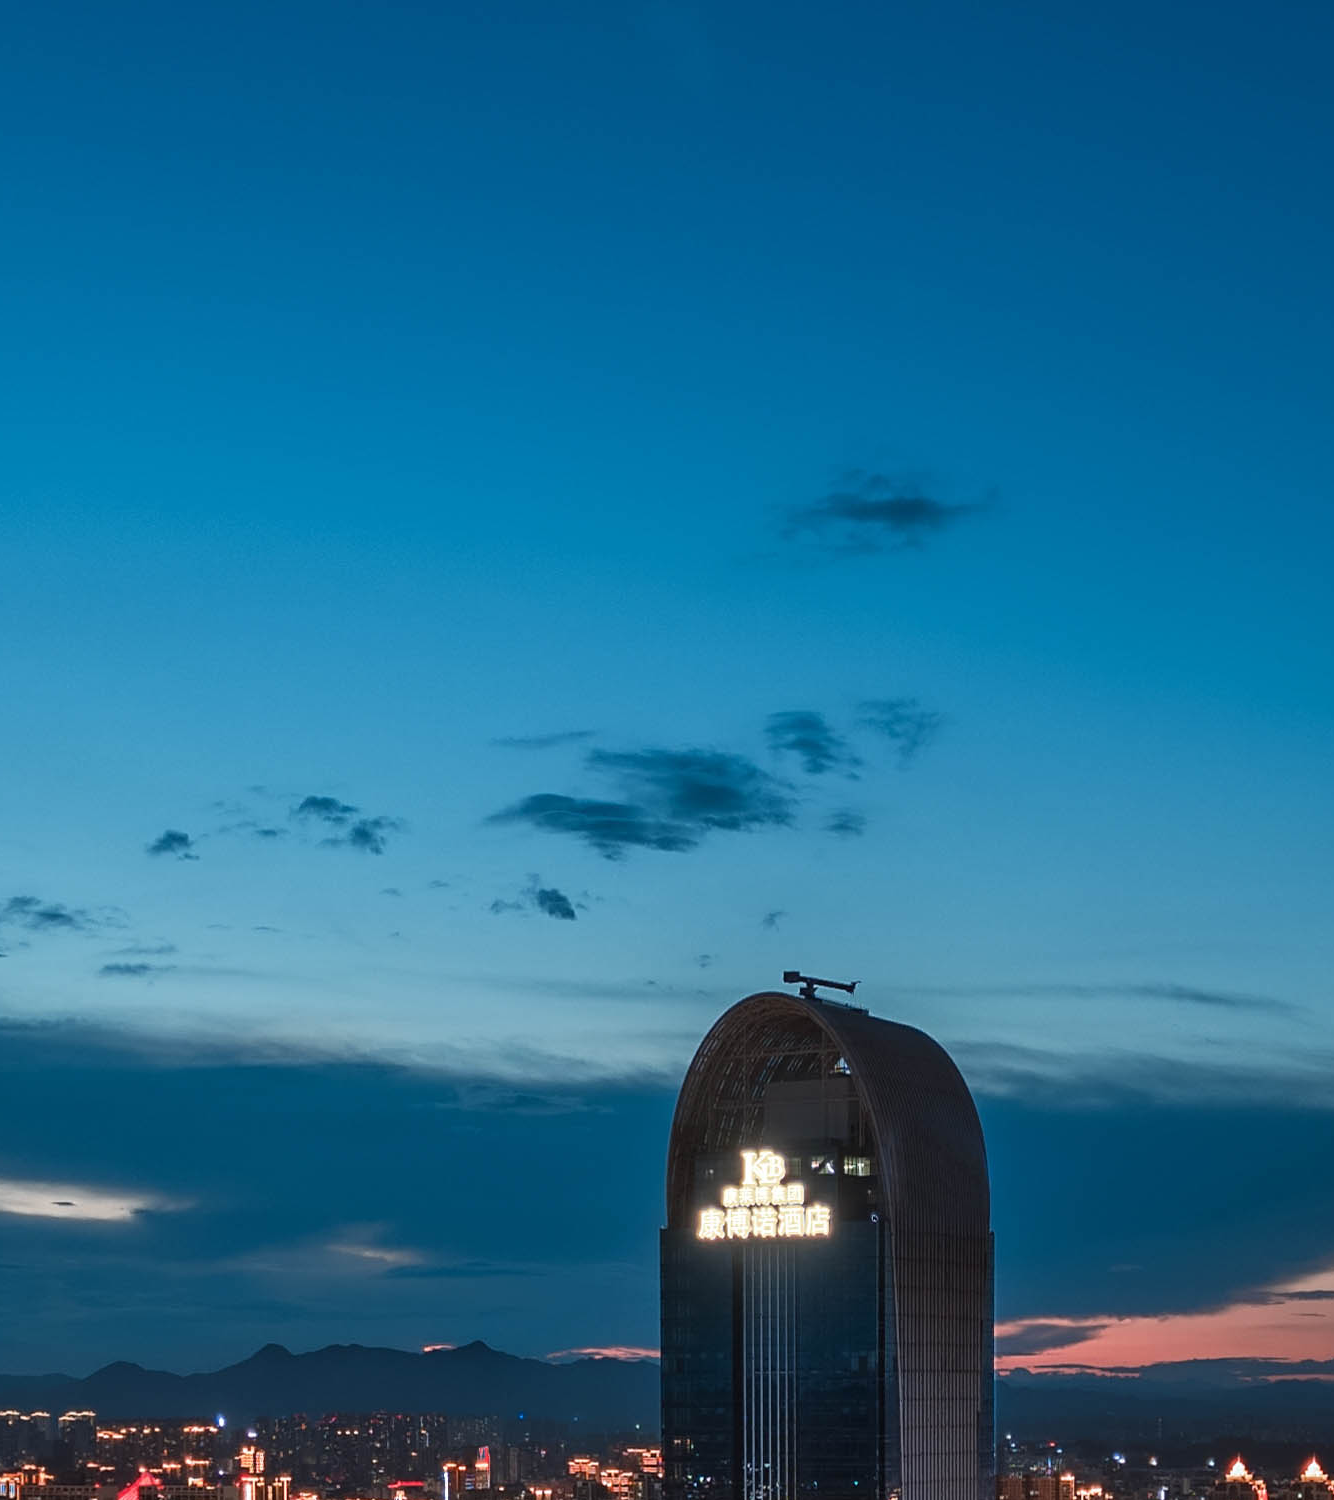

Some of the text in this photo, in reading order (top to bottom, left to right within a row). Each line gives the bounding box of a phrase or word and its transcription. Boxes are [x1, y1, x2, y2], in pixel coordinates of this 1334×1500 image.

[697, 1205, 831, 1240] 康博诺酒店
